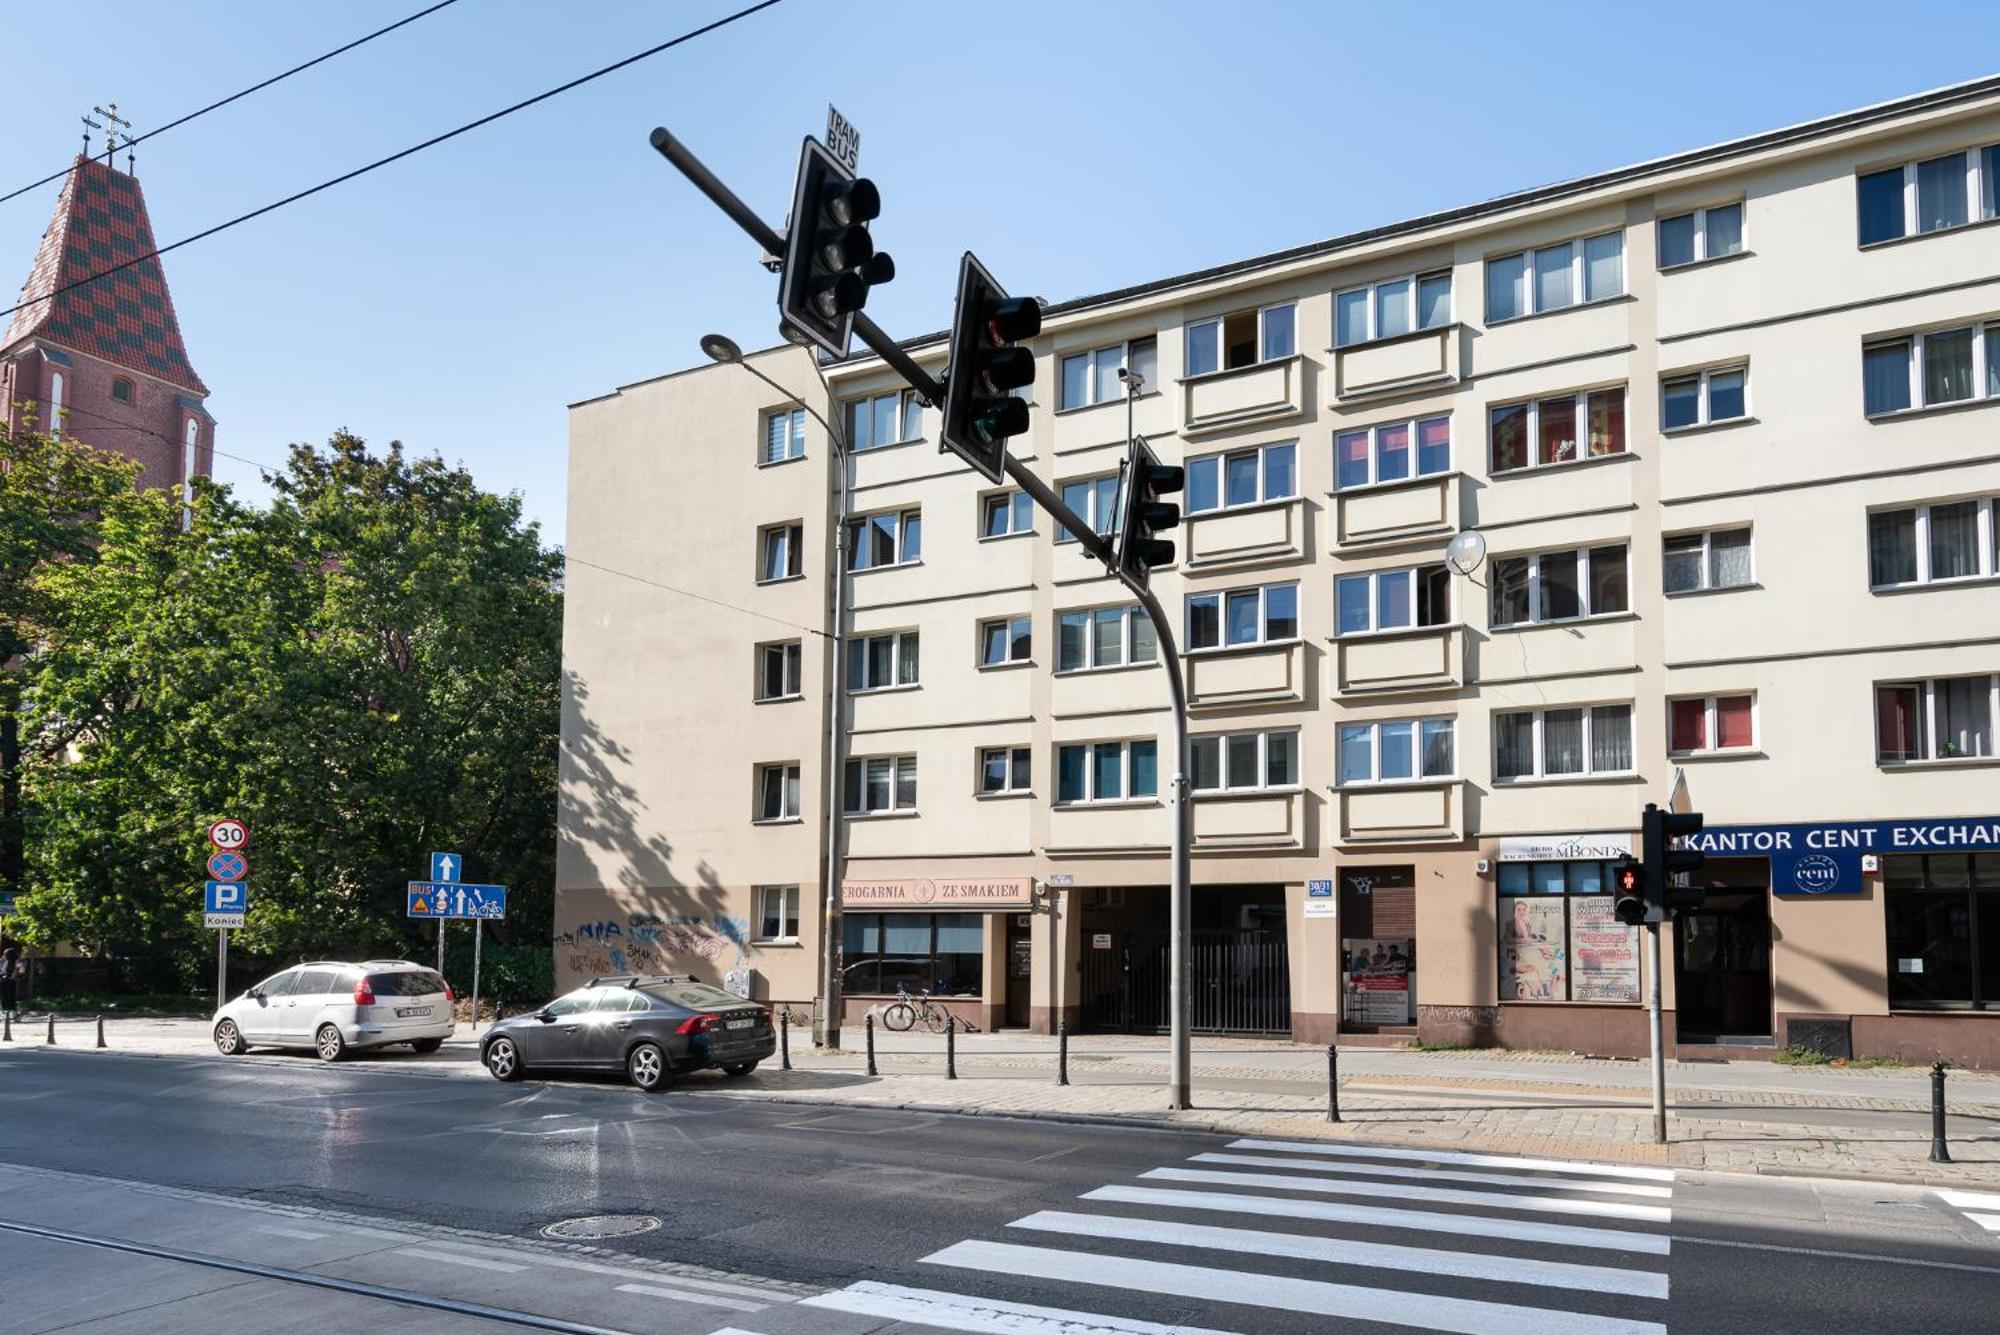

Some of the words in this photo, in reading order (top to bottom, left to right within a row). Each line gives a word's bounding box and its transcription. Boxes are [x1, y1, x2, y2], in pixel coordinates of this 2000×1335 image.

[831, 107, 859, 152] TRAM
[828, 128, 856, 169] BUS
[217, 828, 242, 842] 30
[1684, 831, 1792, 851] KANTOR
[1806, 829, 1877, 849] CENT
[1797, 867, 1835, 879] cent
[215, 885, 238, 909] P
[411, 885, 431, 895] BUS
[942, 886, 959, 898] ZE
[960, 884, 1019, 898] SMAKIEM
[207, 916, 242, 925] Koniec
